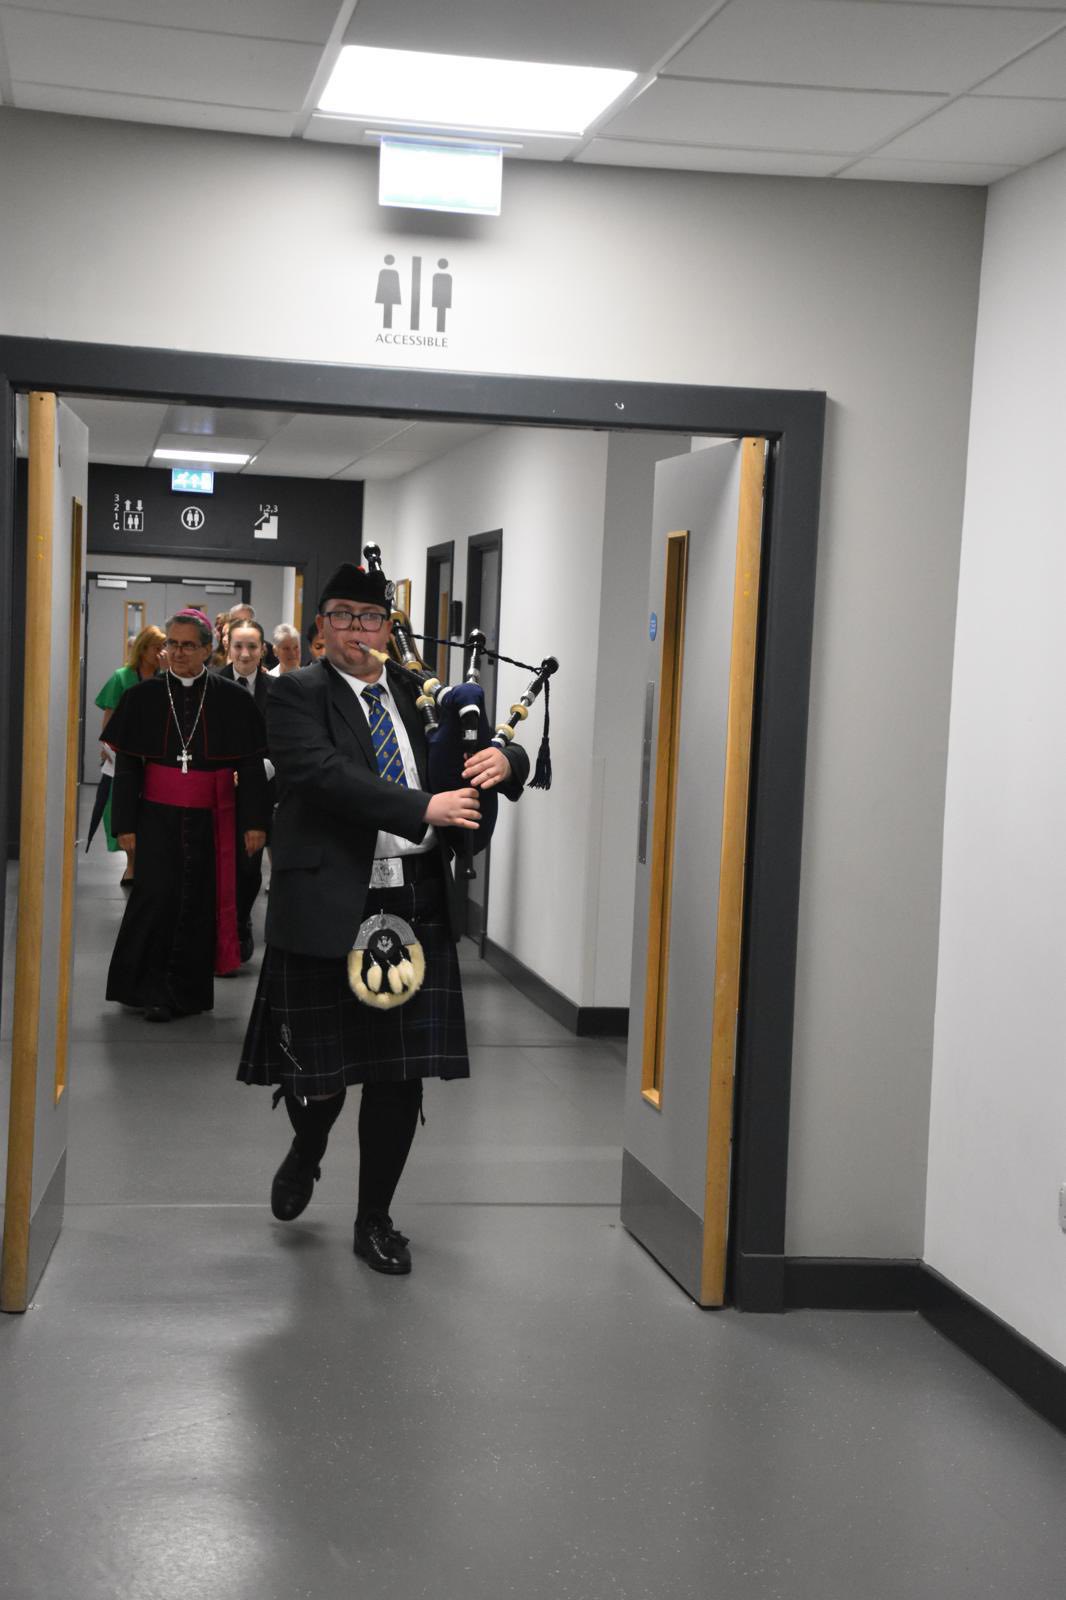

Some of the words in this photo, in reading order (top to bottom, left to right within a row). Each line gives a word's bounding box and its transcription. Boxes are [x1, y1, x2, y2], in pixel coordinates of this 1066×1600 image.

[375, 333, 448, 348] ACCESSIBLE
[114, 493, 120, 502] 3
[114, 503, 120, 511] 2
[113, 522, 120, 530] G
